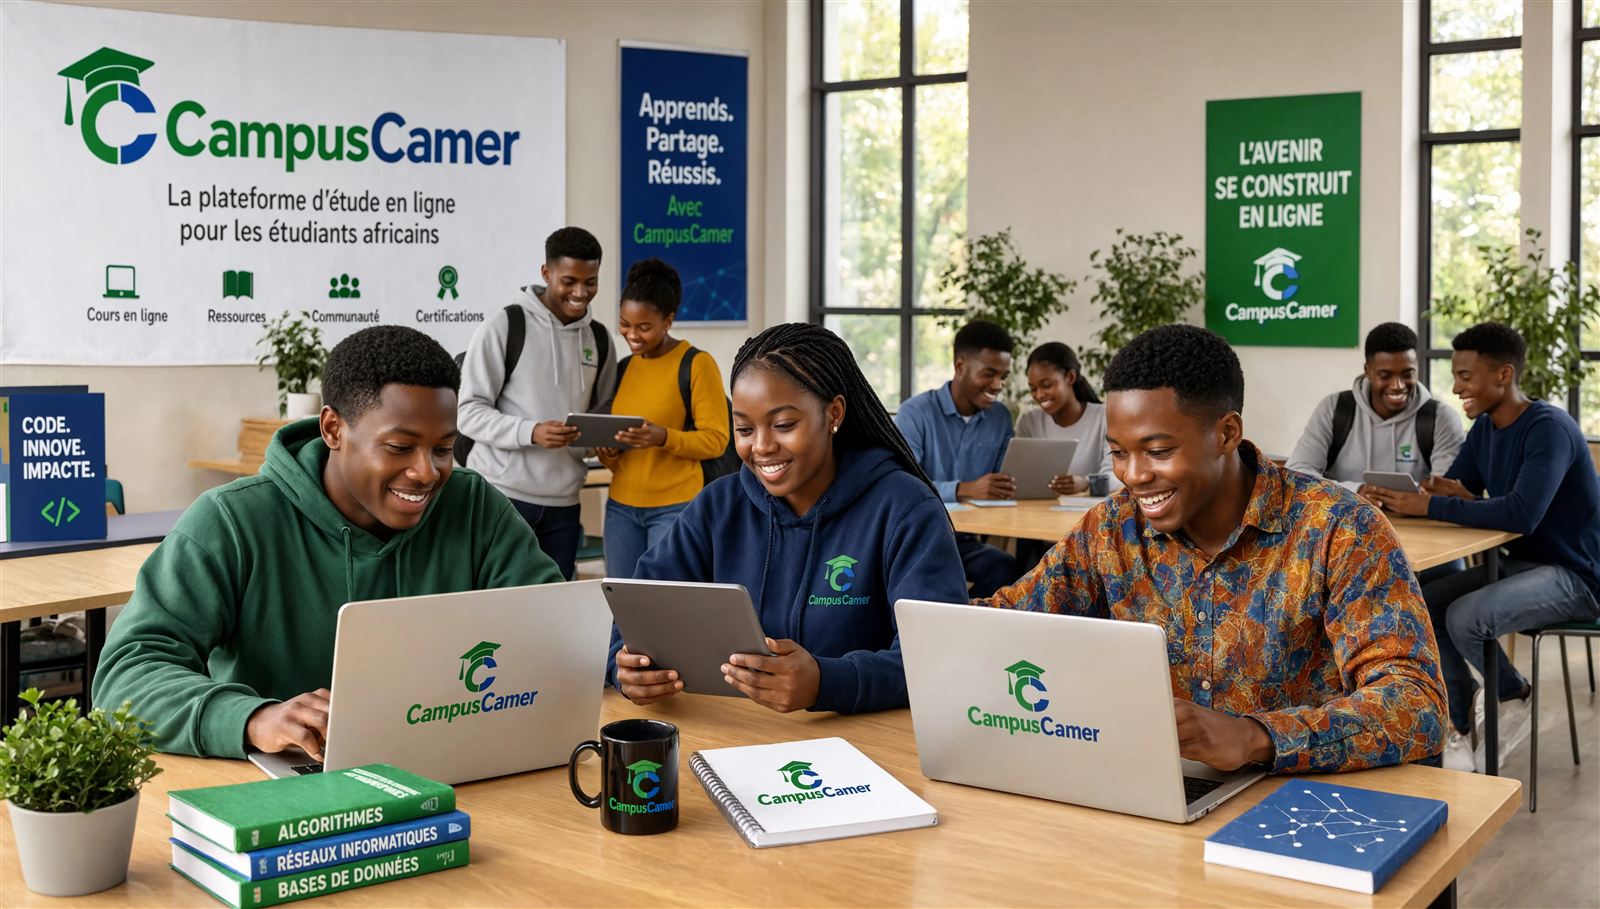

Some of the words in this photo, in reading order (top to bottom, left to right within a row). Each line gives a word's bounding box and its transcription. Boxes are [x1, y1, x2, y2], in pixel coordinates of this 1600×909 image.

[639, 92, 734, 125] Apprends.
[166, 100, 520, 172] CampusCamer
[646, 126, 724, 158] Partage.
[1239, 138, 1323, 165] L'AVENIR
[648, 158, 722, 185] Réussis.
[1215, 176, 1238, 200] SE
[1241, 170, 1352, 199] CONSTRUIT
[168, 183, 191, 207] La
[199, 184, 306, 212] plateforme
[312, 188, 380, 213] d'étude
[386, 197, 407, 213] en
[413, 191, 456, 219] ligne
[667, 195, 703, 216] Avec
[1239, 205, 1264, 228] EN
[1268, 203, 1323, 227] LIGNE
[180, 222, 227, 246] pour
[235, 219, 262, 242] les
[269, 219, 357, 244] étudiants
[363, 221, 439, 244] africains
[634, 223, 734, 248] CampusCamer
[87, 307, 120, 322] Cours
[123, 309, 137, 322] en
[141, 308, 168, 326] ligne
[208, 309, 266, 323] Ressources
[312, 309, 380, 323] Communauté
[416, 309, 485, 323] Certifications
[1225, 301, 1338, 324] CampusCamer
[22, 416, 71, 434] CODE.
[23, 438, 86, 457] INNOVE.
[23, 461, 96, 480] IMPACTE.
[808, 594, 870, 607] CampusCamer
[406, 690, 538, 725] CampusCamer
[967, 706, 1100, 742] CampusCamer
[757, 784, 871, 805] CampusCamer
[278, 806, 384, 842] ALGORITHMES
[277, 845, 337, 872] RÉSEAUX
[341, 826, 438, 859] INFORMATIQUES
[278, 875, 327, 899] BASES
[331, 869, 349, 887] DE
[353, 856, 419, 882] DONNÉES
